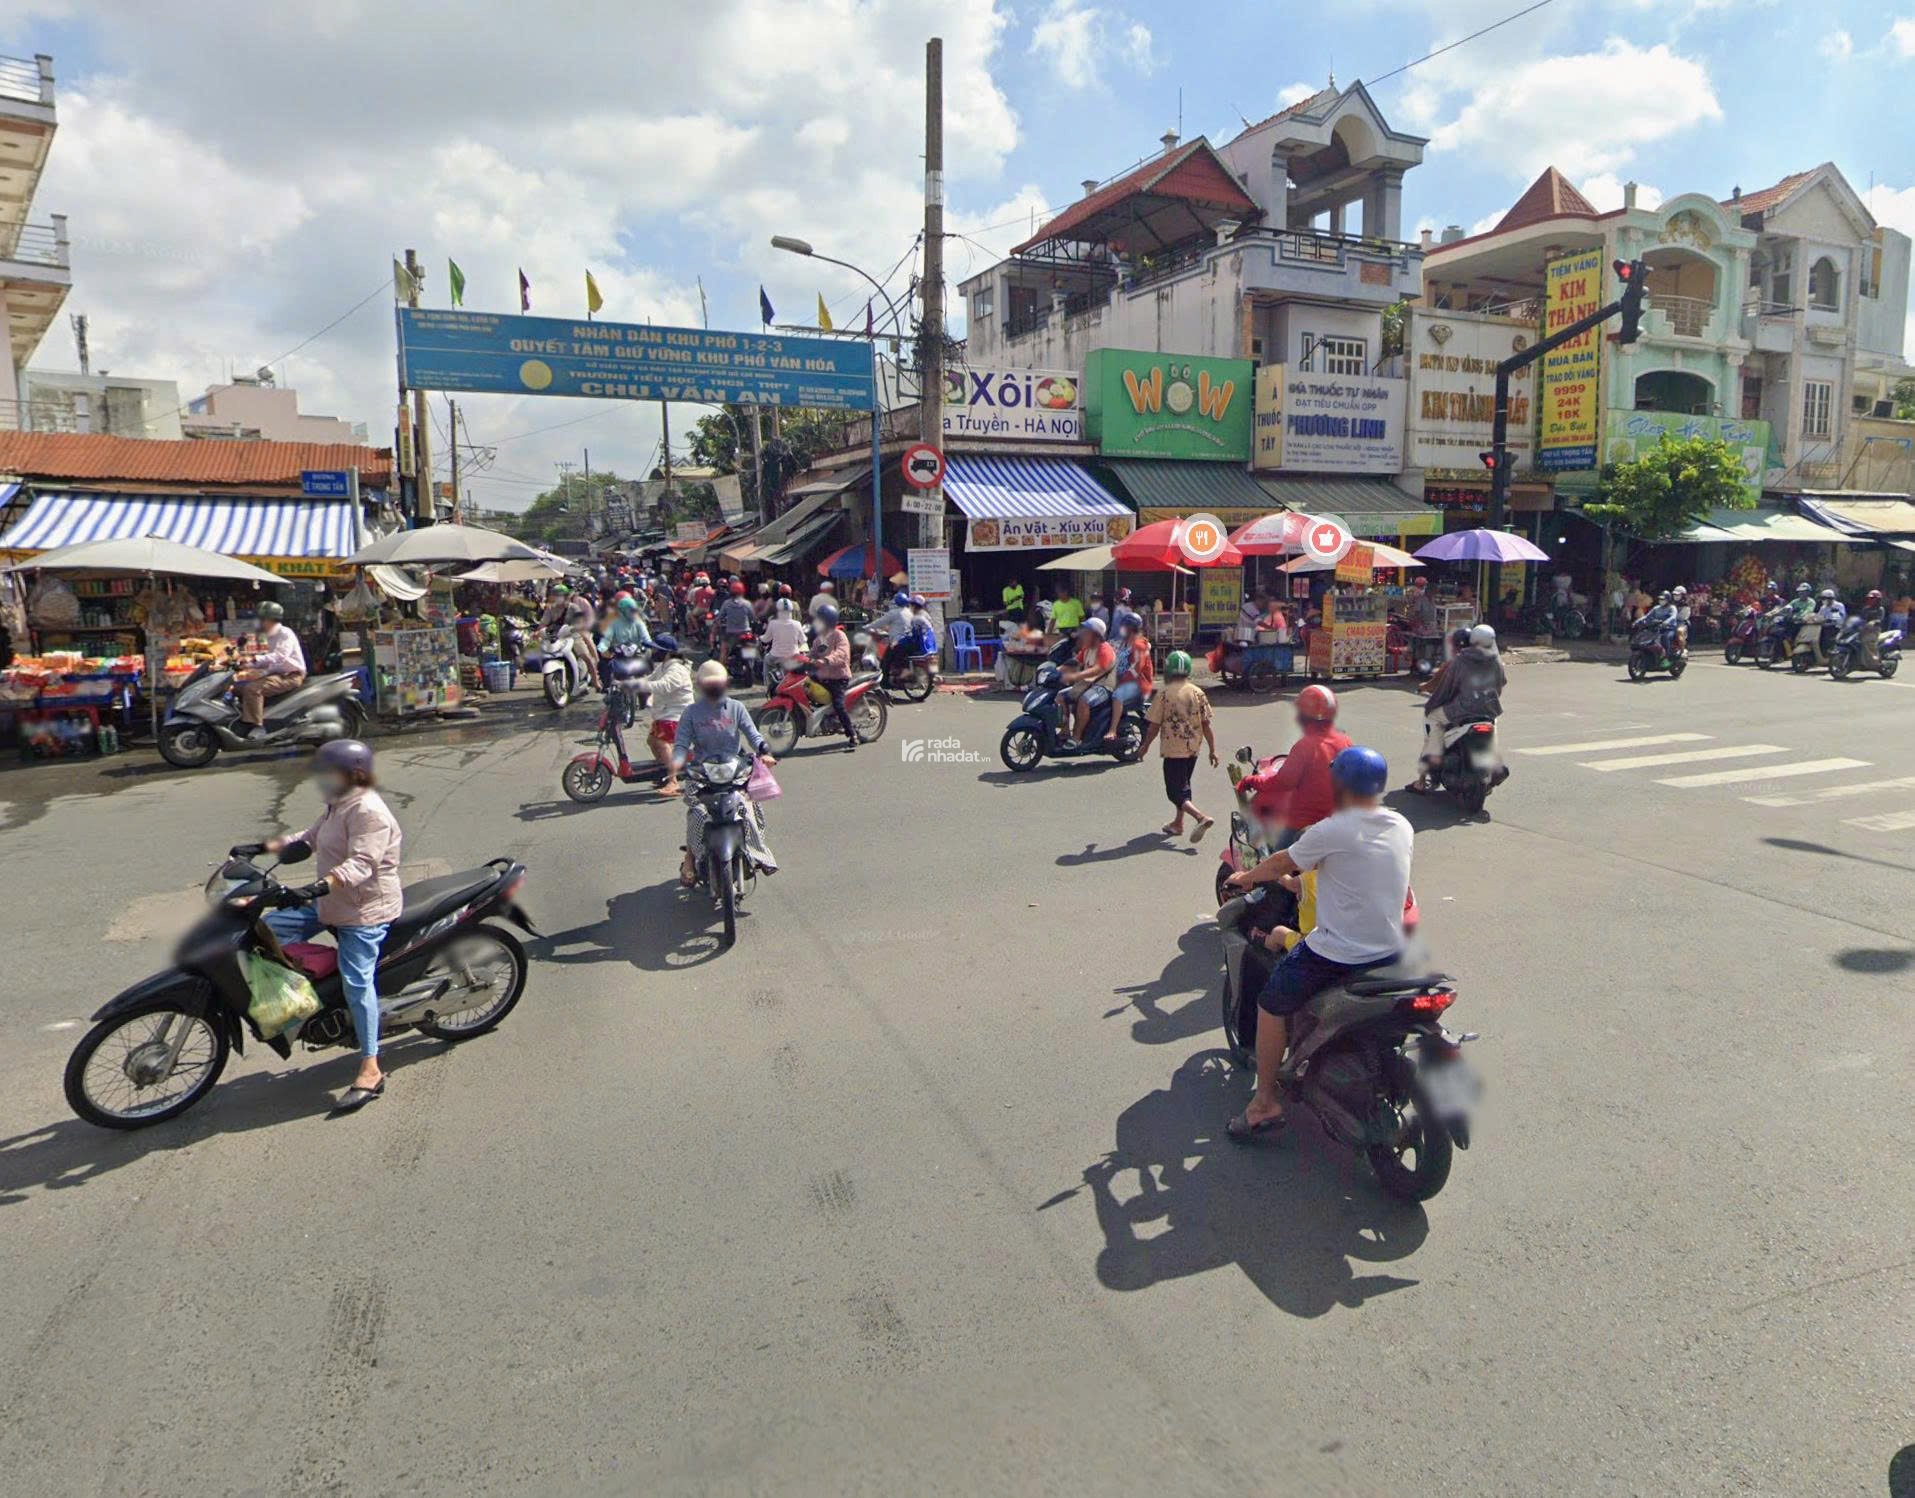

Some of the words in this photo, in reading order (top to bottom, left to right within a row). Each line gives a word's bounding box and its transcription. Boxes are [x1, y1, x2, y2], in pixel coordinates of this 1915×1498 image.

[1560, 278, 1586, 301] KIM
[573, 325, 622, 341] NHÂN
[667, 331, 699, 346] KHU
[705, 334, 737, 349] PHỐ
[743, 339, 783, 352] 1-2-3
[510, 336, 566, 354] QUYẾT
[572, 342, 609, 358] TÂM
[697, 352, 729, 365] KHU
[734, 352, 766, 369] PHỐ
[1548, 356, 1569, 367] MUA
[1573, 350, 1593, 363] BÁN
[581, 382, 651, 398] CHU
[736, 390, 780, 404] AN
[759, 382, 790, 390] THPT
[967, 372, 1032, 408] Xôi
[1309, 381, 1344, 397] THUỐC
[1554, 384, 1586, 396] 9999
[1557, 397, 1580, 408] 24K
[1257, 407, 1281, 427] THUỐC
[1558, 408, 1580, 420] 18K
[956, 412, 1010, 435] Truyền
[1024, 414, 1046, 434] HÀ
[1051, 416, 1077, 438] NỘI
[1351, 417, 1386, 440] LINH
[1003, 519, 1020, 535] Ăn
[1024, 521, 1047, 538] Vặt
[1059, 520, 1080, 533] Xíu
[1084, 519, 1104, 532] Xíu
